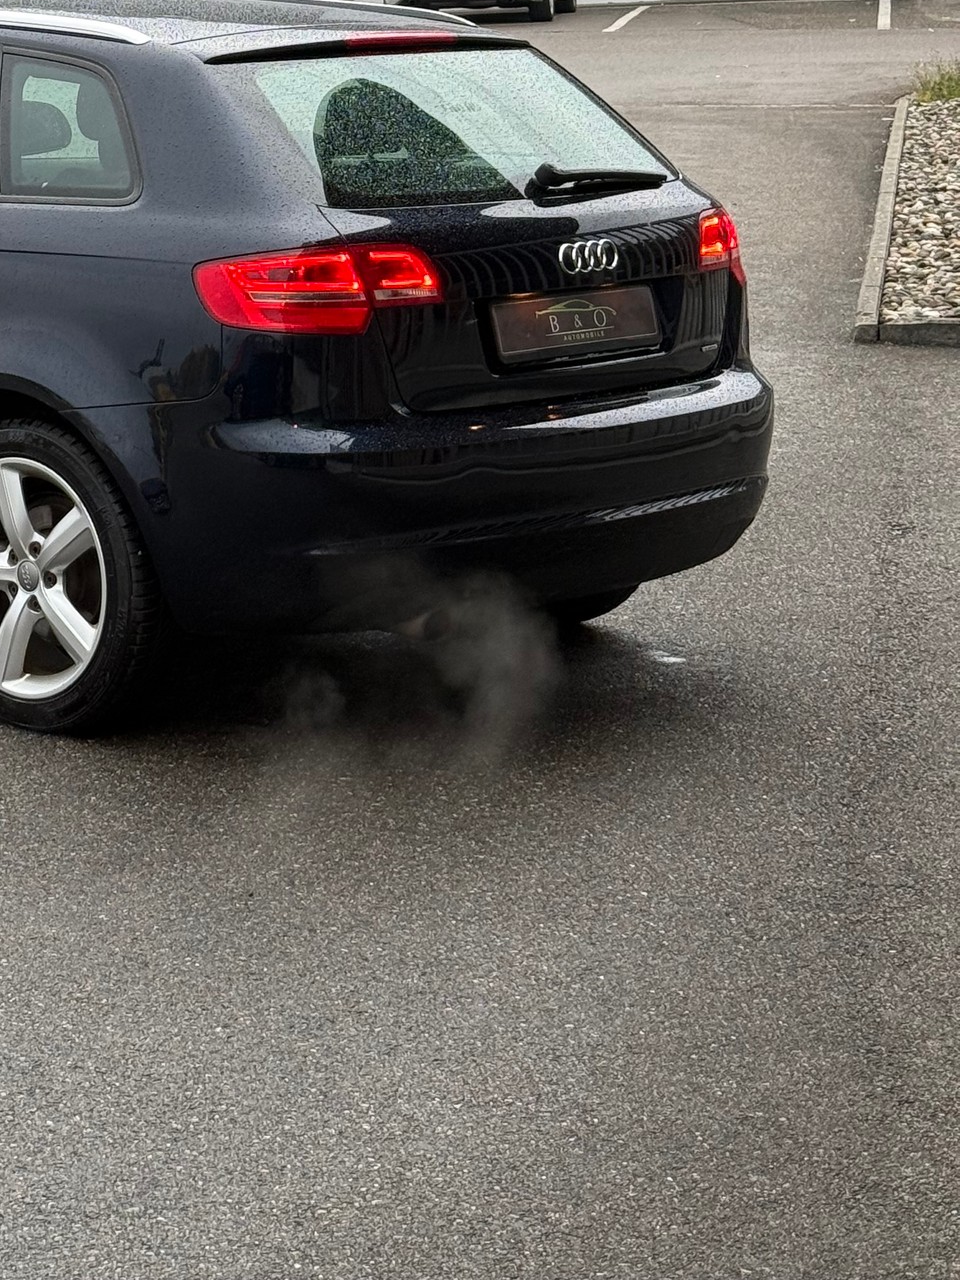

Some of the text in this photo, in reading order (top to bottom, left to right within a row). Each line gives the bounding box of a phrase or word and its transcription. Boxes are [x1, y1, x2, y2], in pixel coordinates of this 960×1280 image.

[548, 309, 607, 333] B & O
[563, 330, 606, 341] AUTOMOBILE
